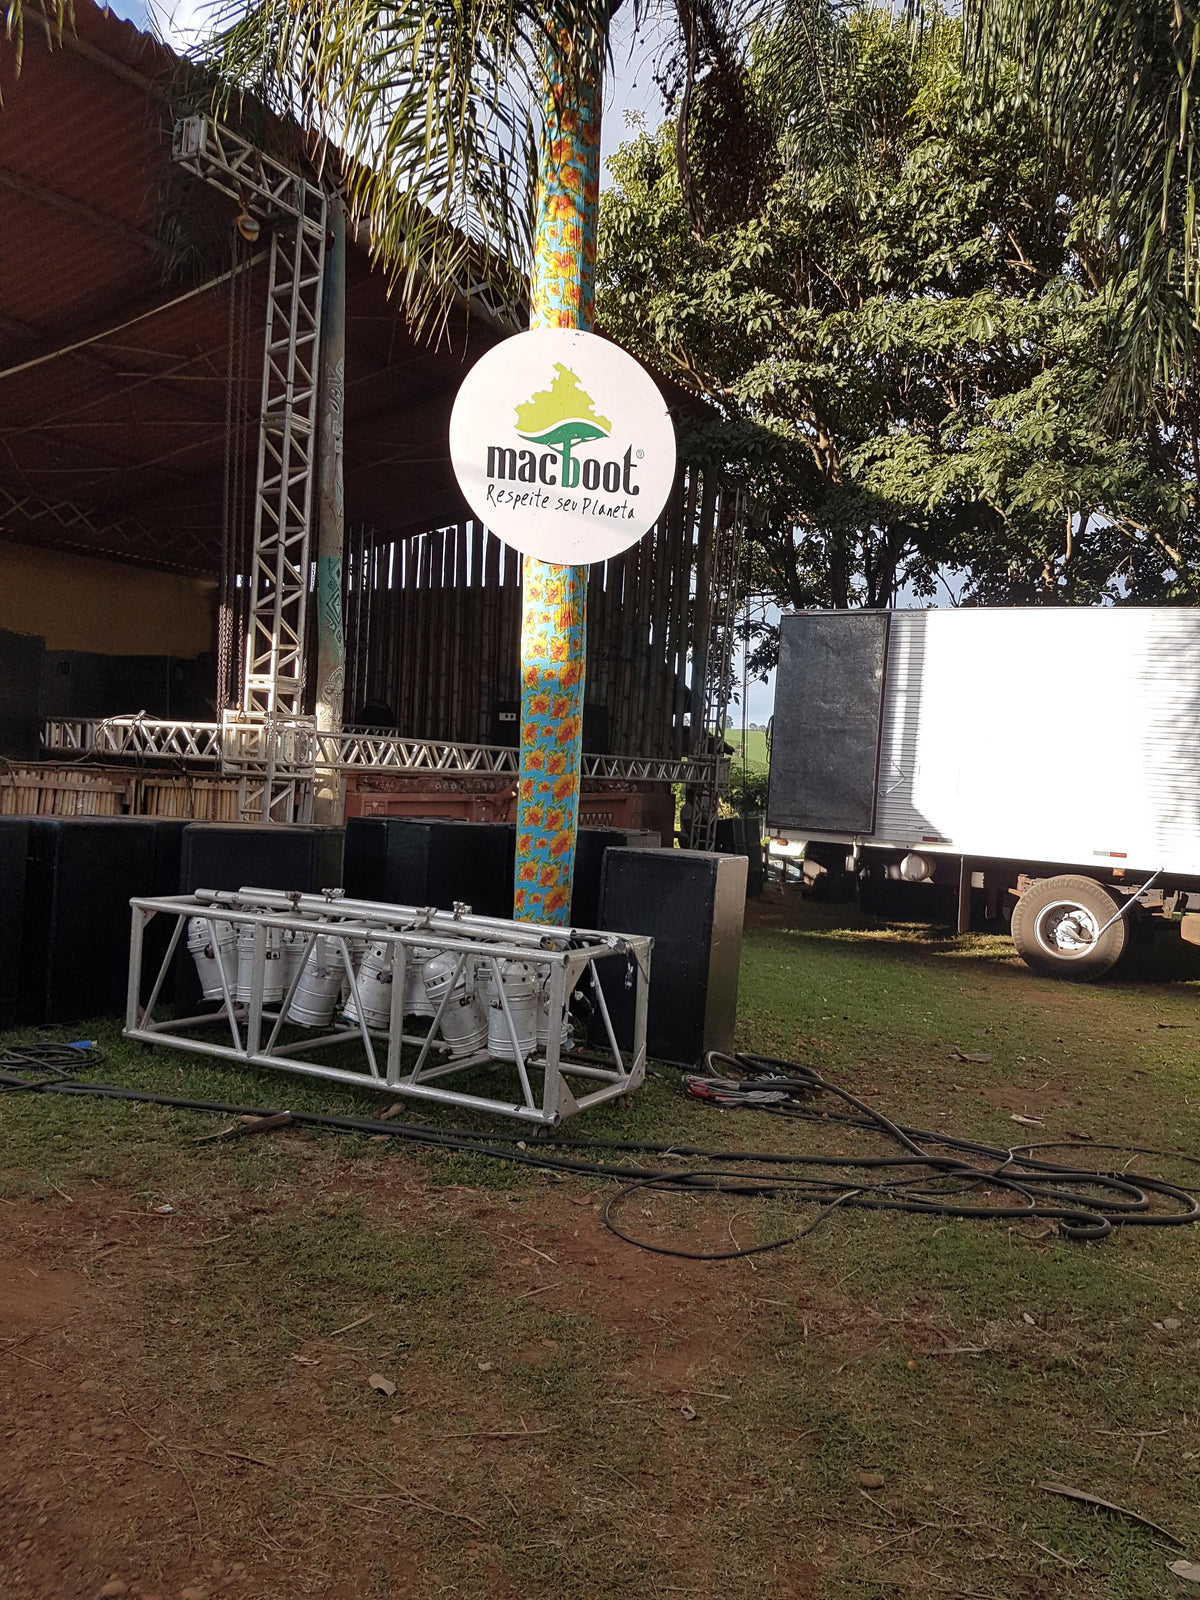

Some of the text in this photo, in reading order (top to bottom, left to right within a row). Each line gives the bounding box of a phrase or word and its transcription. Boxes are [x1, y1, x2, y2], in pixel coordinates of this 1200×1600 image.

[487, 443, 640, 496] macboot
[486, 484, 550, 510] Respeite
[582, 497, 636, 520] Planeta
